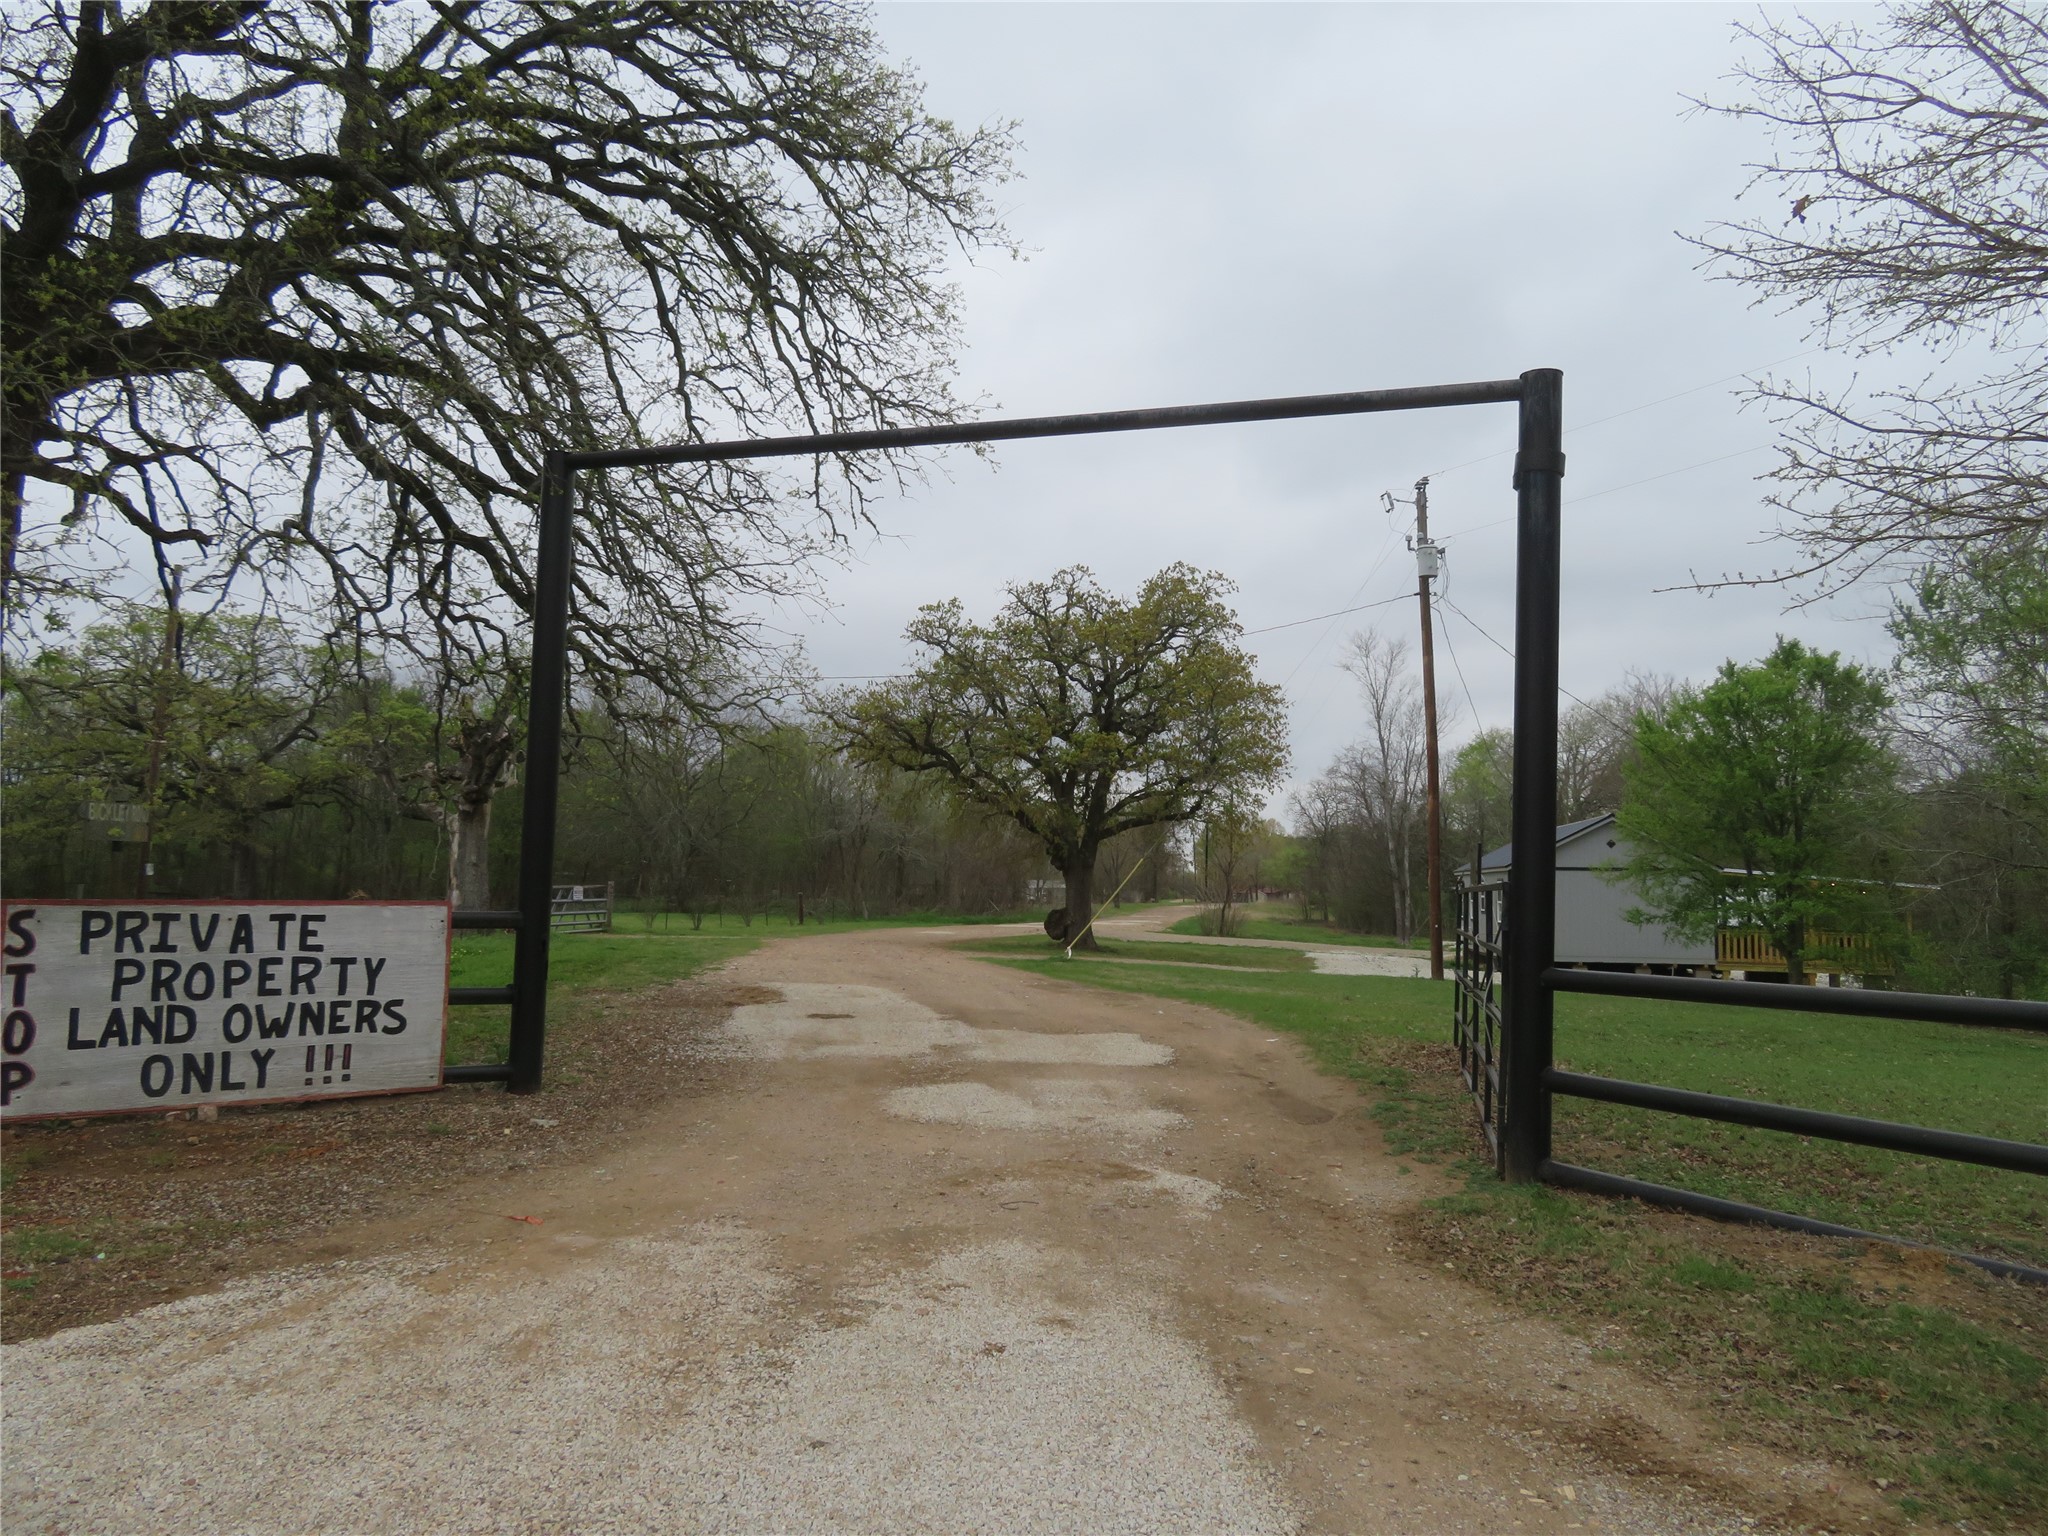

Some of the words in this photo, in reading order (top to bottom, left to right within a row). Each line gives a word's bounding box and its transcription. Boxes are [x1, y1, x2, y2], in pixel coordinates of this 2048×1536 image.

[80, 909, 327, 956] PRIVATE
[111, 956, 387, 1002] PROPERTY
[1, 908, 37, 1106] STOP
[66, 1003, 198, 1051] LAND
[221, 998, 408, 1045] OWNERS
[139, 1047, 277, 1099] ONLY
